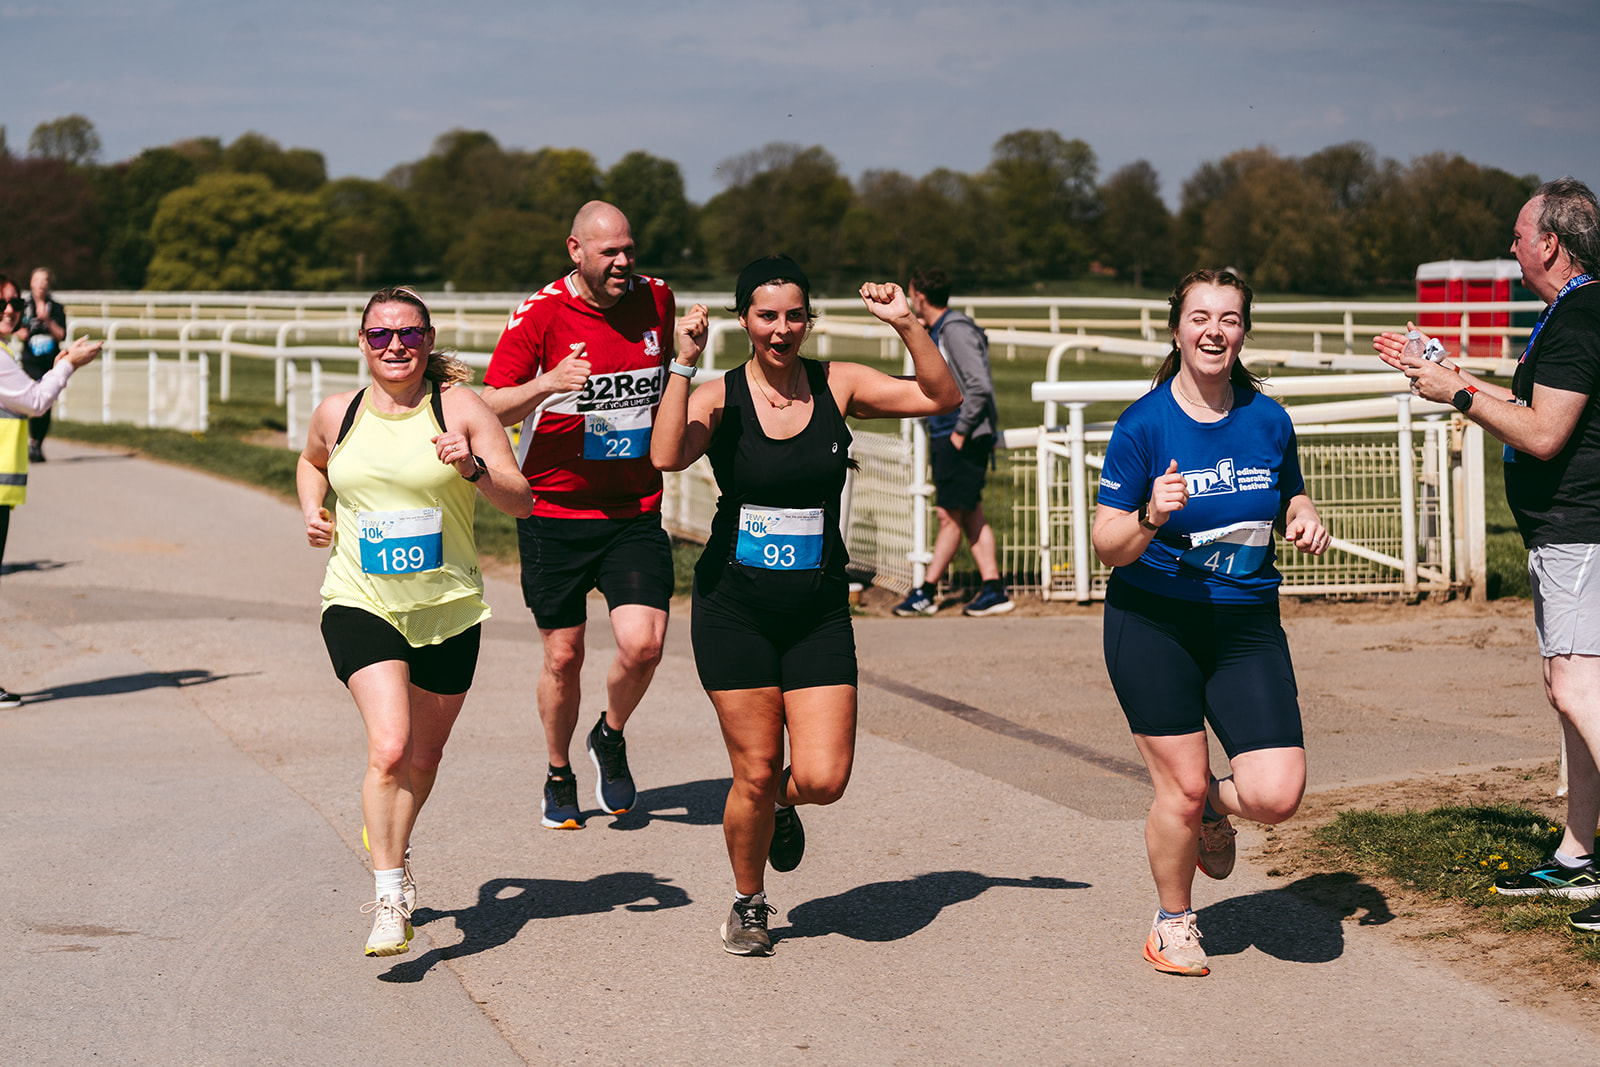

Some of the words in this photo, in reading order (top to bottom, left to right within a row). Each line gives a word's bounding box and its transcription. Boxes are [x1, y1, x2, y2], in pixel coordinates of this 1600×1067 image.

[577, 368, 661, 401] 32Red
[609, 401, 629, 409] YOUR
[630, 397, 650, 406] LIMITS
[589, 423, 608, 433] 10k
[605, 437, 631, 457] 22
[1239, 482, 1269, 491] festival
[745, 513, 765, 521] TEWV
[362, 527, 384, 539] 10k
[745, 521, 767, 534] 10k
[377, 546, 424, 571] 189
[763, 544, 796, 567] 93
[1204, 551, 1235, 574] 41
